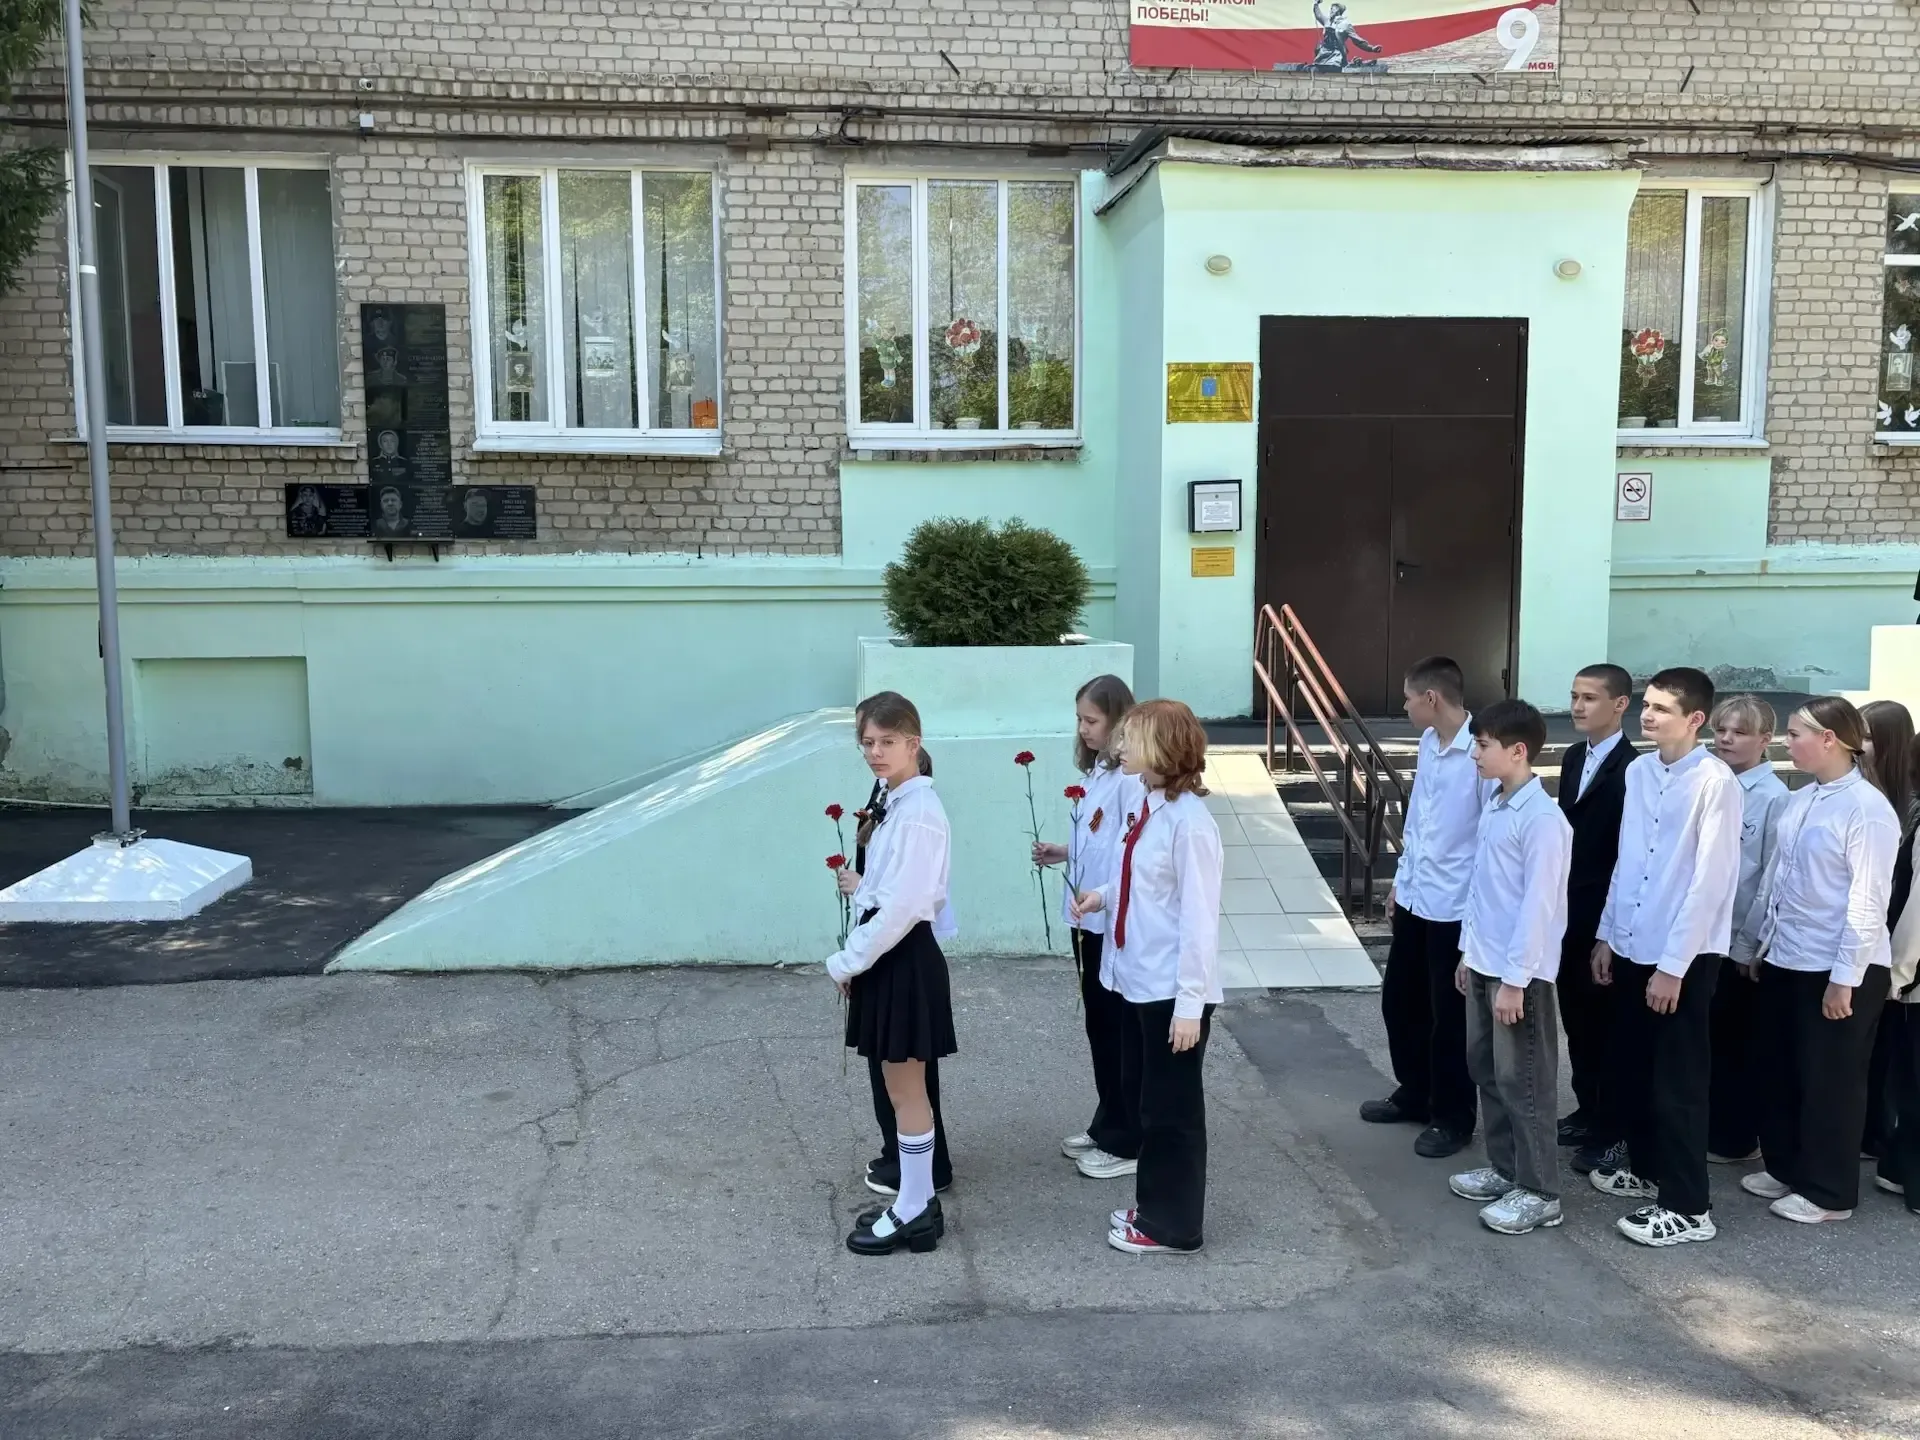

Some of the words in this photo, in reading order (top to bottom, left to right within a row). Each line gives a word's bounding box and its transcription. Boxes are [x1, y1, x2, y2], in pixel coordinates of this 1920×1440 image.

[1137, 6, 1209, 22] ПОБЕДЫ!
[1496, 7, 1539, 70] 9
[1527, 62, 1554, 70] мая
